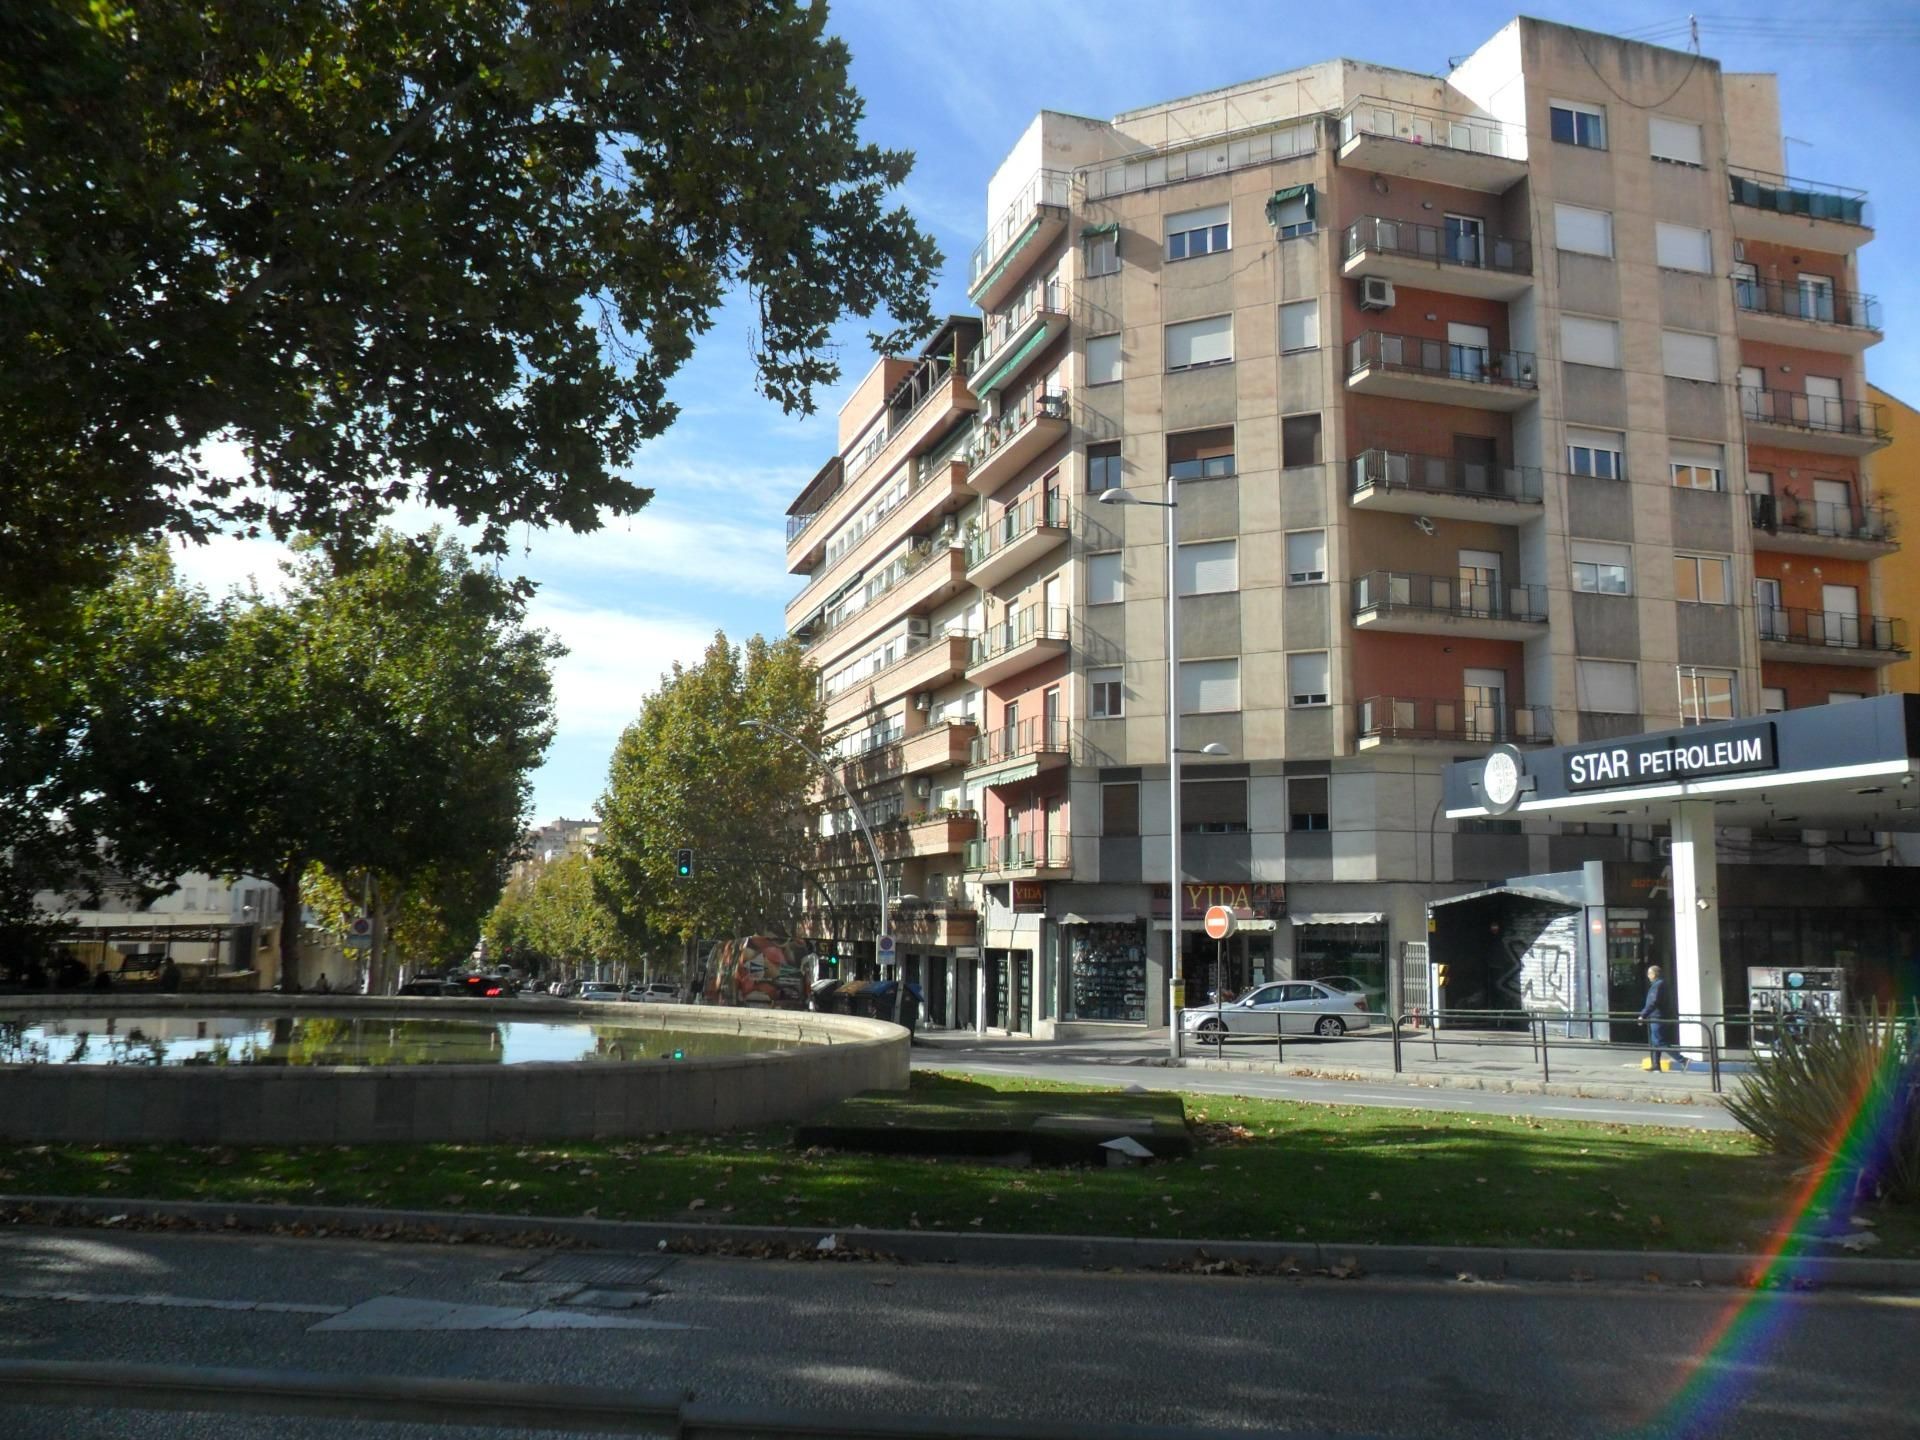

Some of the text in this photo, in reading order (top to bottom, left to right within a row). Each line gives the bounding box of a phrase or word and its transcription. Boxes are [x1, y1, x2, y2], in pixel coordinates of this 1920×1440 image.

[1570, 737, 1762, 784] STAR PETROLEUM
[1186, 885, 1251, 910] YIDA
